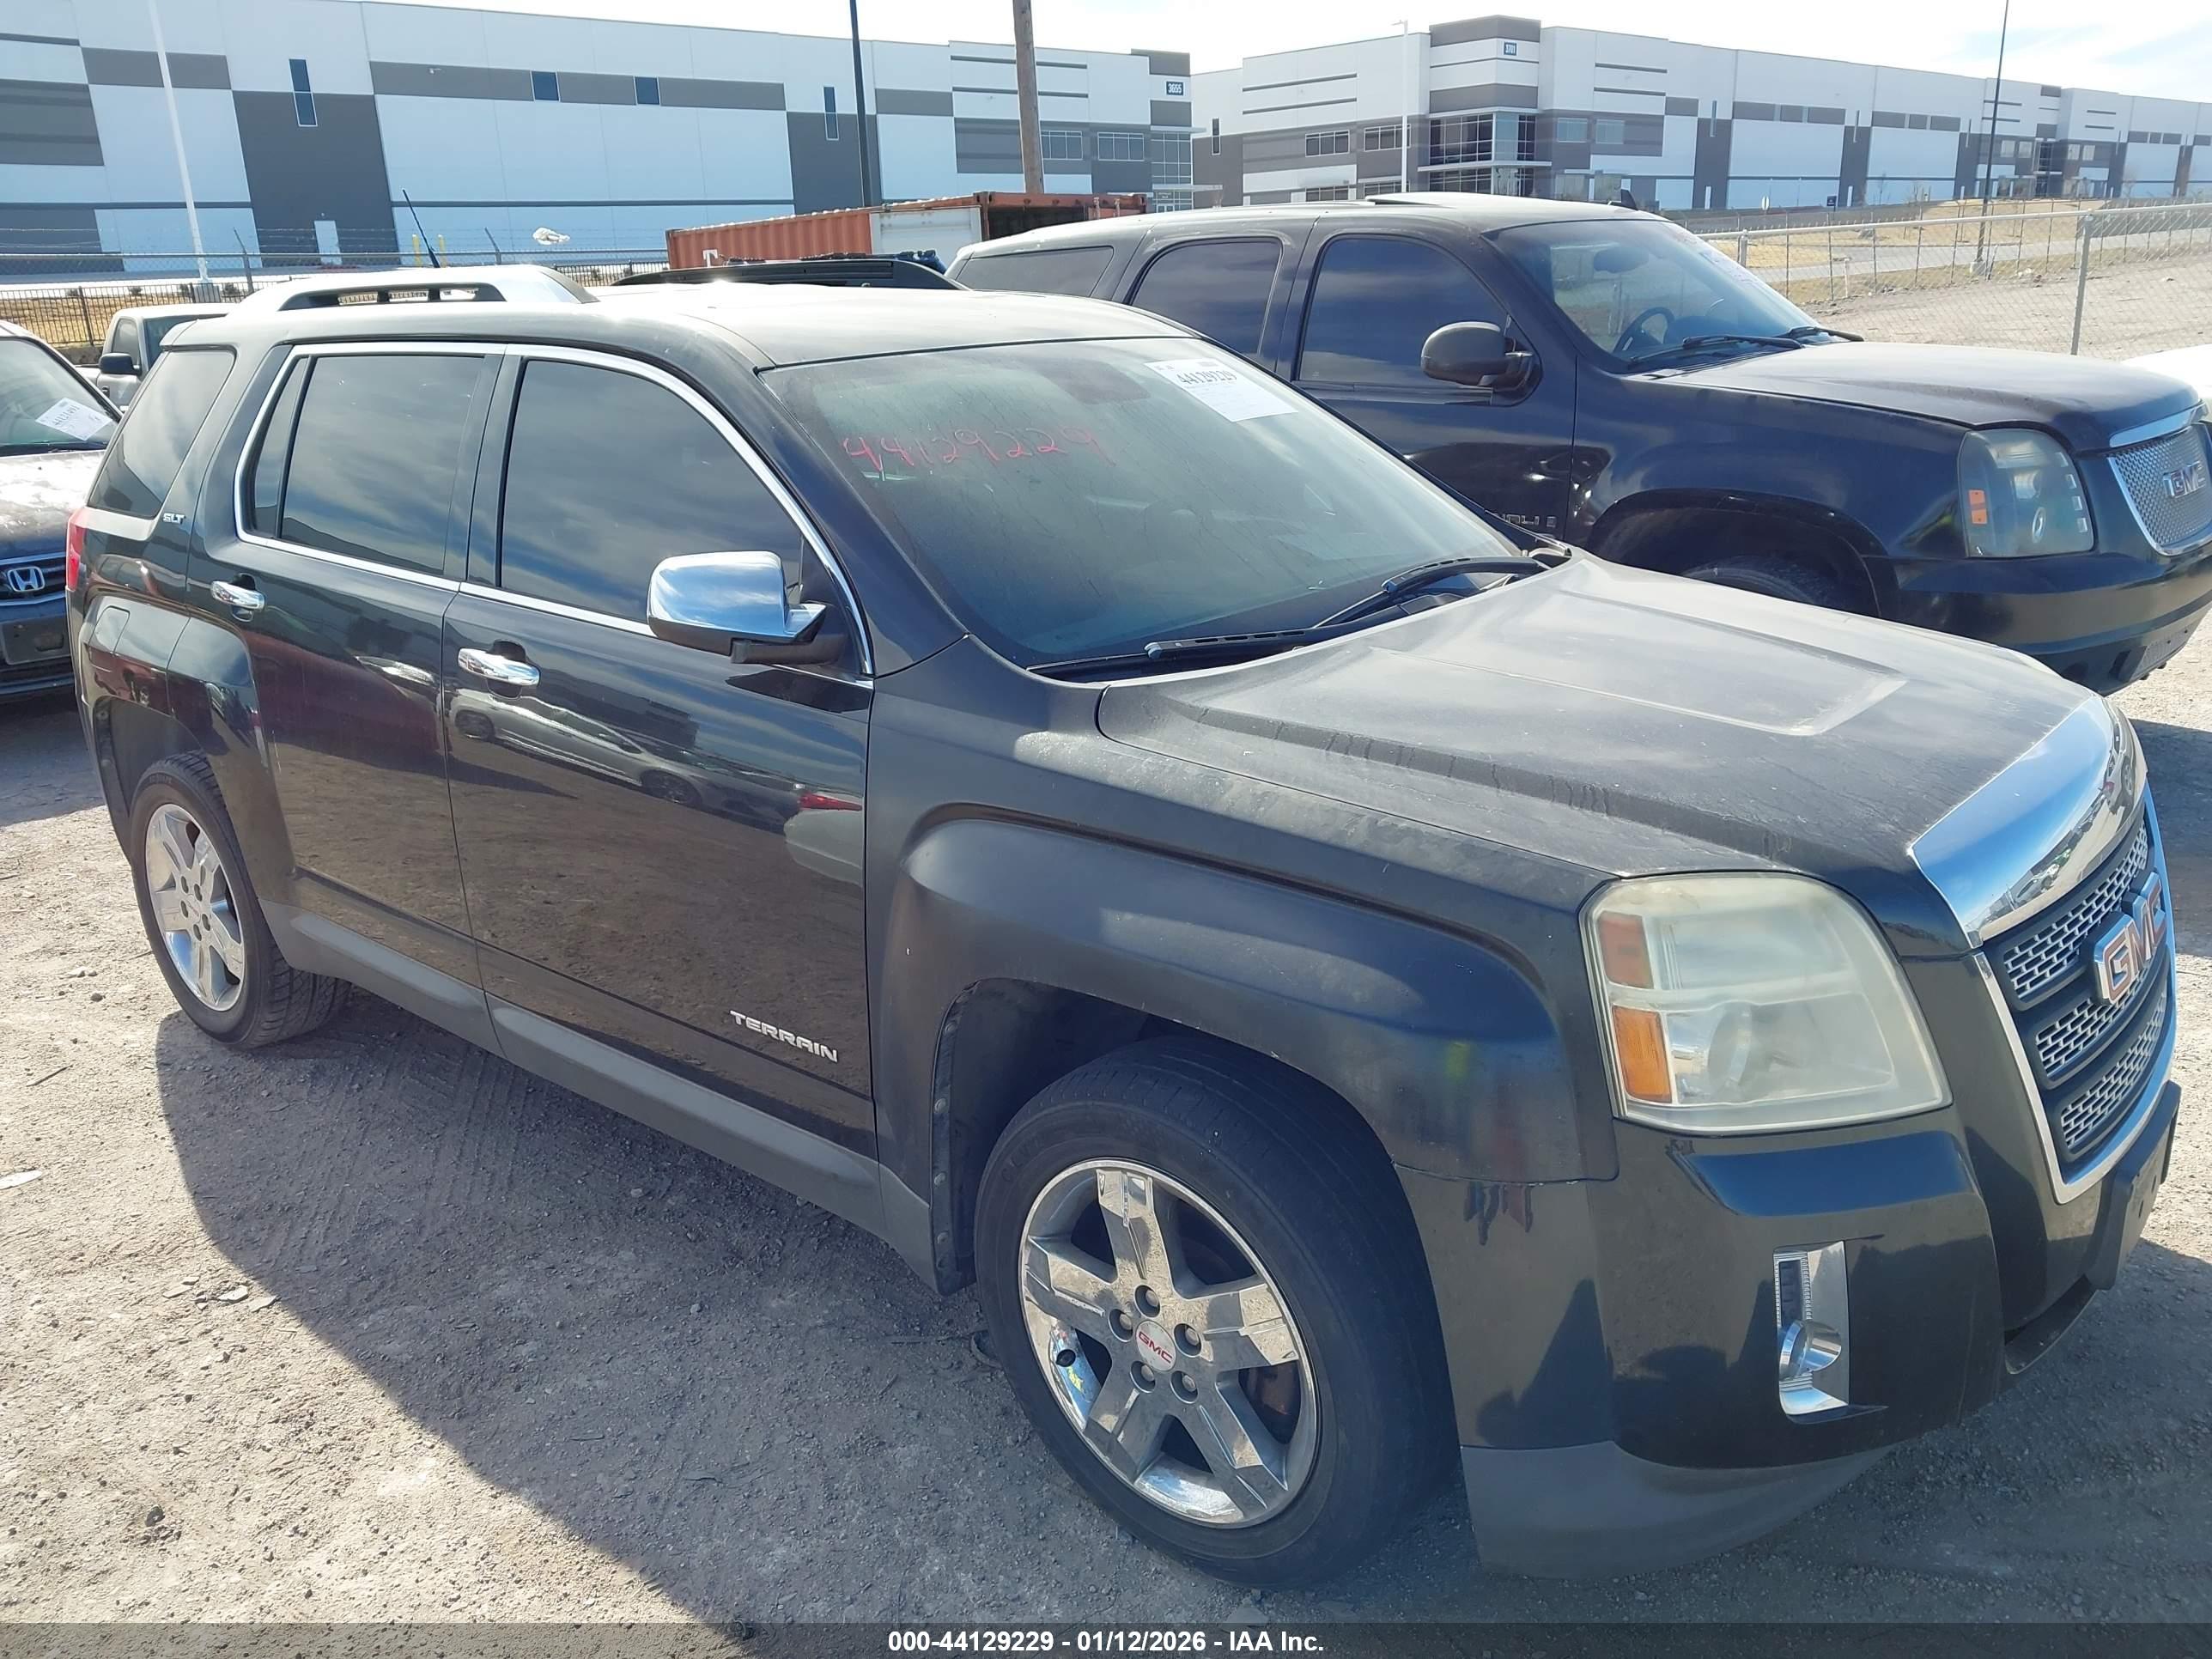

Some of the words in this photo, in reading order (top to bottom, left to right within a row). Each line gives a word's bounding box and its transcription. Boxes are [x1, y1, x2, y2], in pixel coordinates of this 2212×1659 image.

[843, 428, 1116, 471] 44129229
[2162, 460, 2206, 498] GMC
[163, 513, 185, 525] SLT
[2094, 872, 2167, 1004] GMC
[729, 1009, 838, 1063] TERRAIN
[1138, 1331, 1173, 1364] GMC
